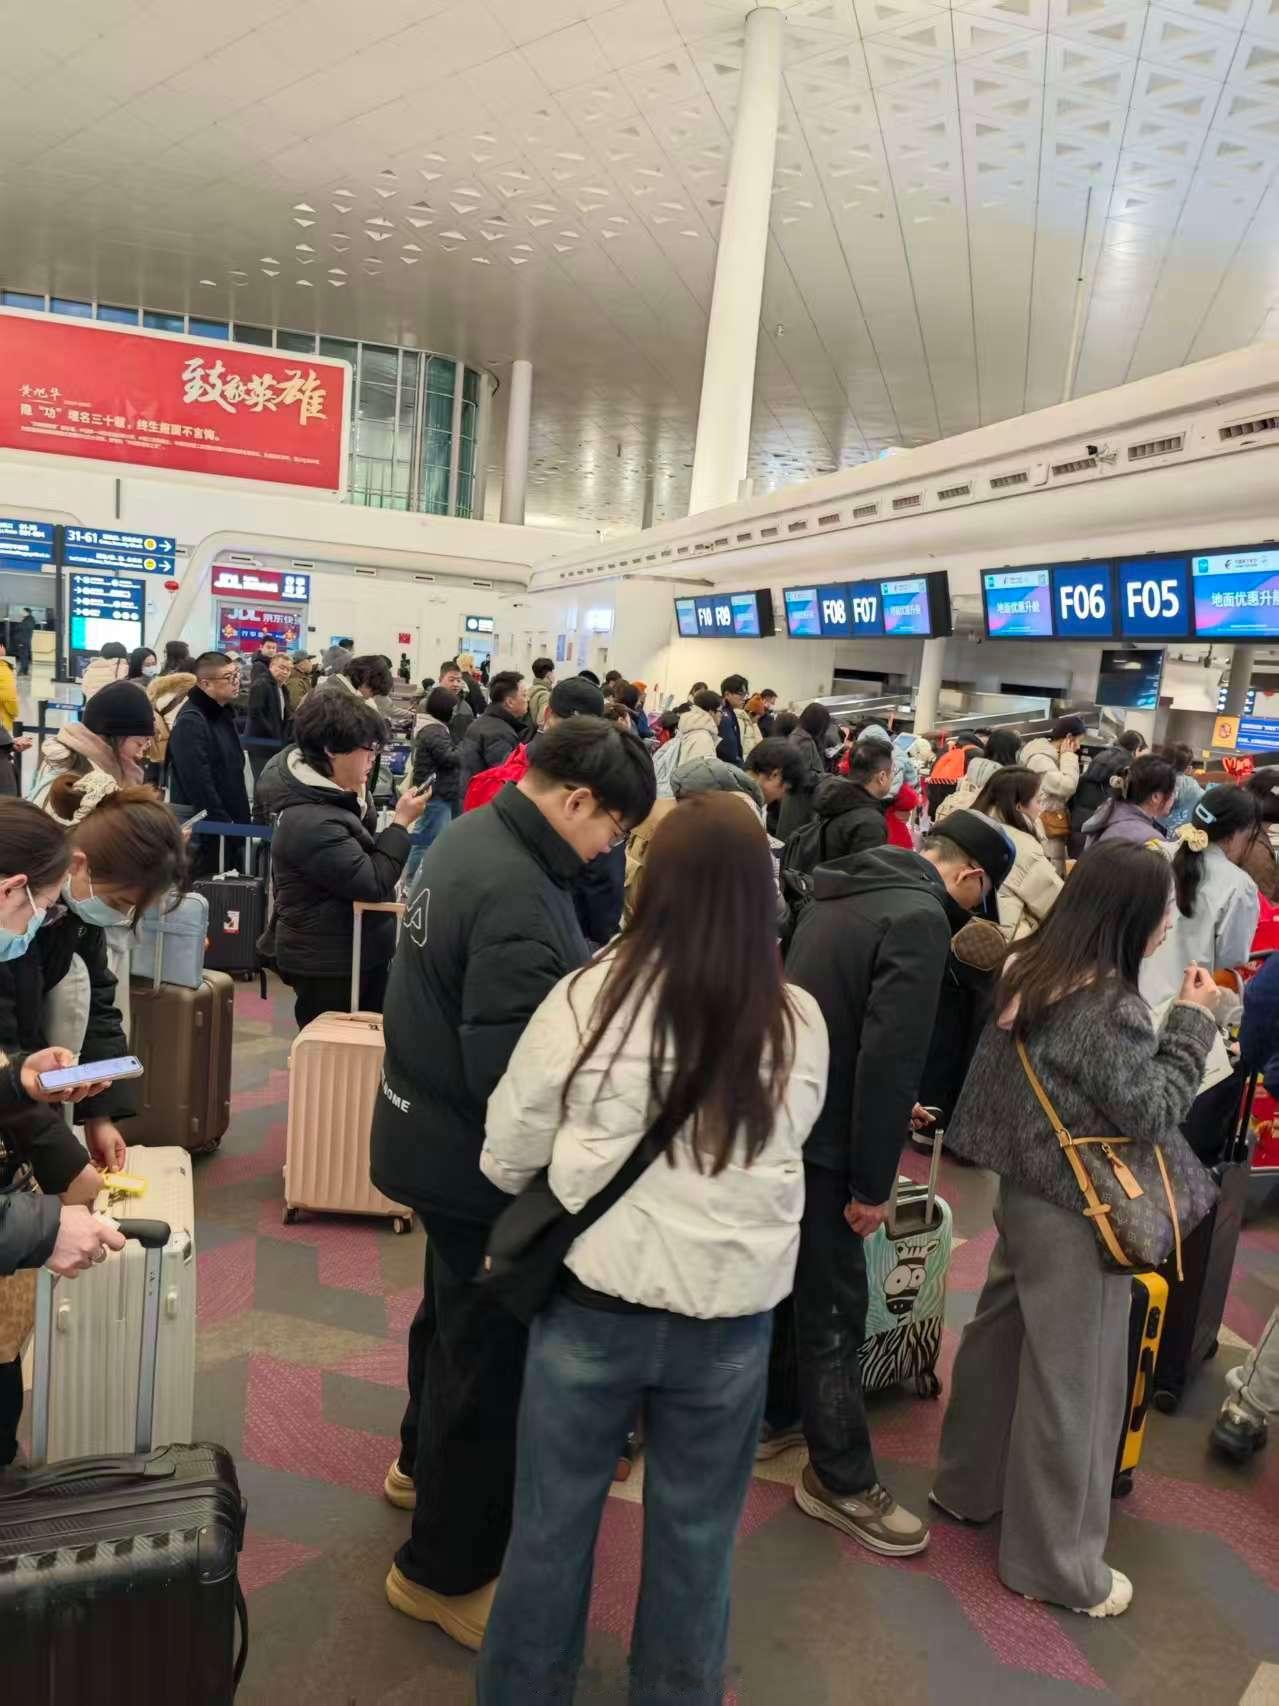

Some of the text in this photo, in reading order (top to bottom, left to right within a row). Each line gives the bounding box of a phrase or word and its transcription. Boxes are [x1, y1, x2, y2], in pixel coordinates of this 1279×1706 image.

[181, 357, 328, 426] 致敬英雄
[67, 529, 98, 544] 31-61
[823, 599, 847, 624] F08
[852, 596, 877, 623] F07
[1059, 579, 1180, 620] F06 F05
[697, 605, 731, 626] F10 F09
